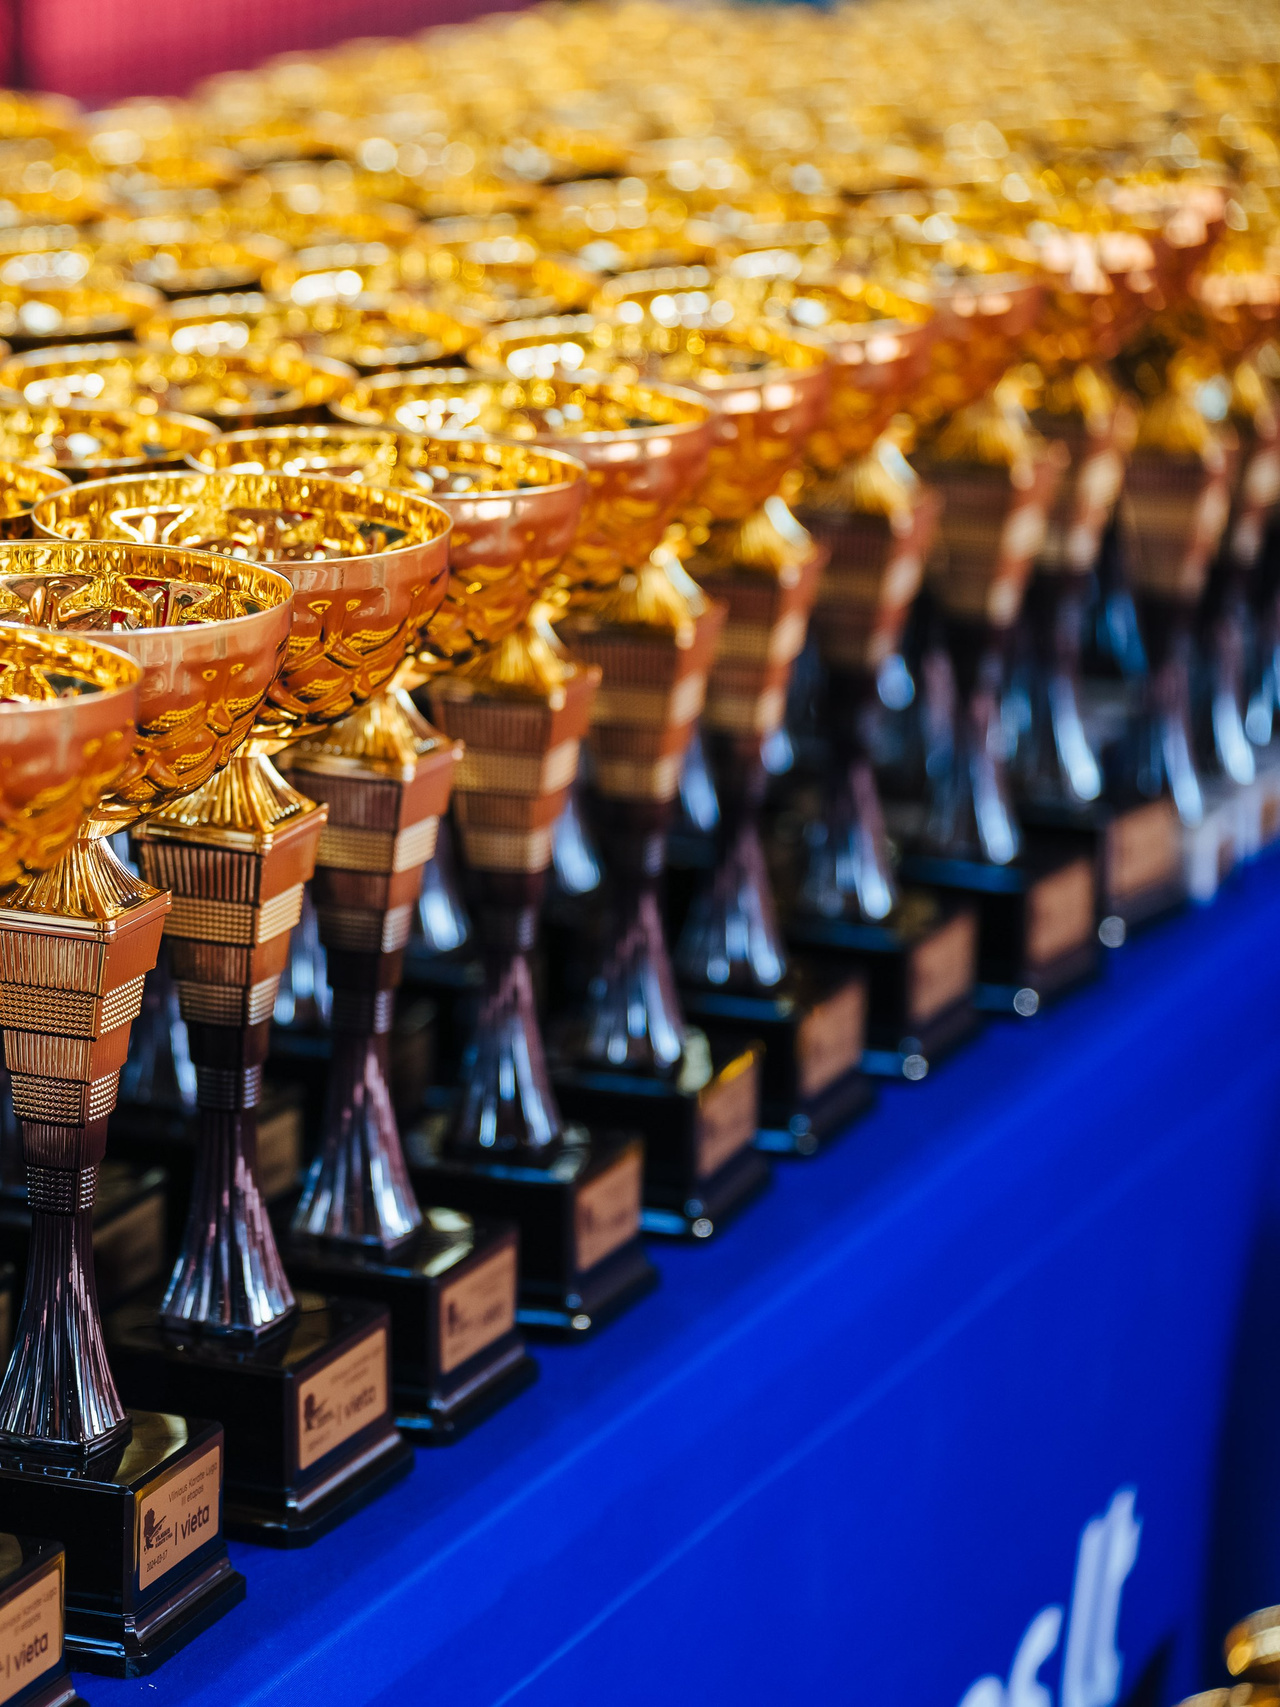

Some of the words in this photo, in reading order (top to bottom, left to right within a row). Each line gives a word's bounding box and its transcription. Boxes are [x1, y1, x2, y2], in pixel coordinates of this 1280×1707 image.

[168, 1482, 188, 1502] Vilniaus
[188, 1470, 205, 1488] Karate
[205, 1462, 217, 1476] Lyga
[187, 1484, 204, 1502] etapas
[180, 1505, 210, 1540] vieta
[14, 1632, 48, 1671] vieta
